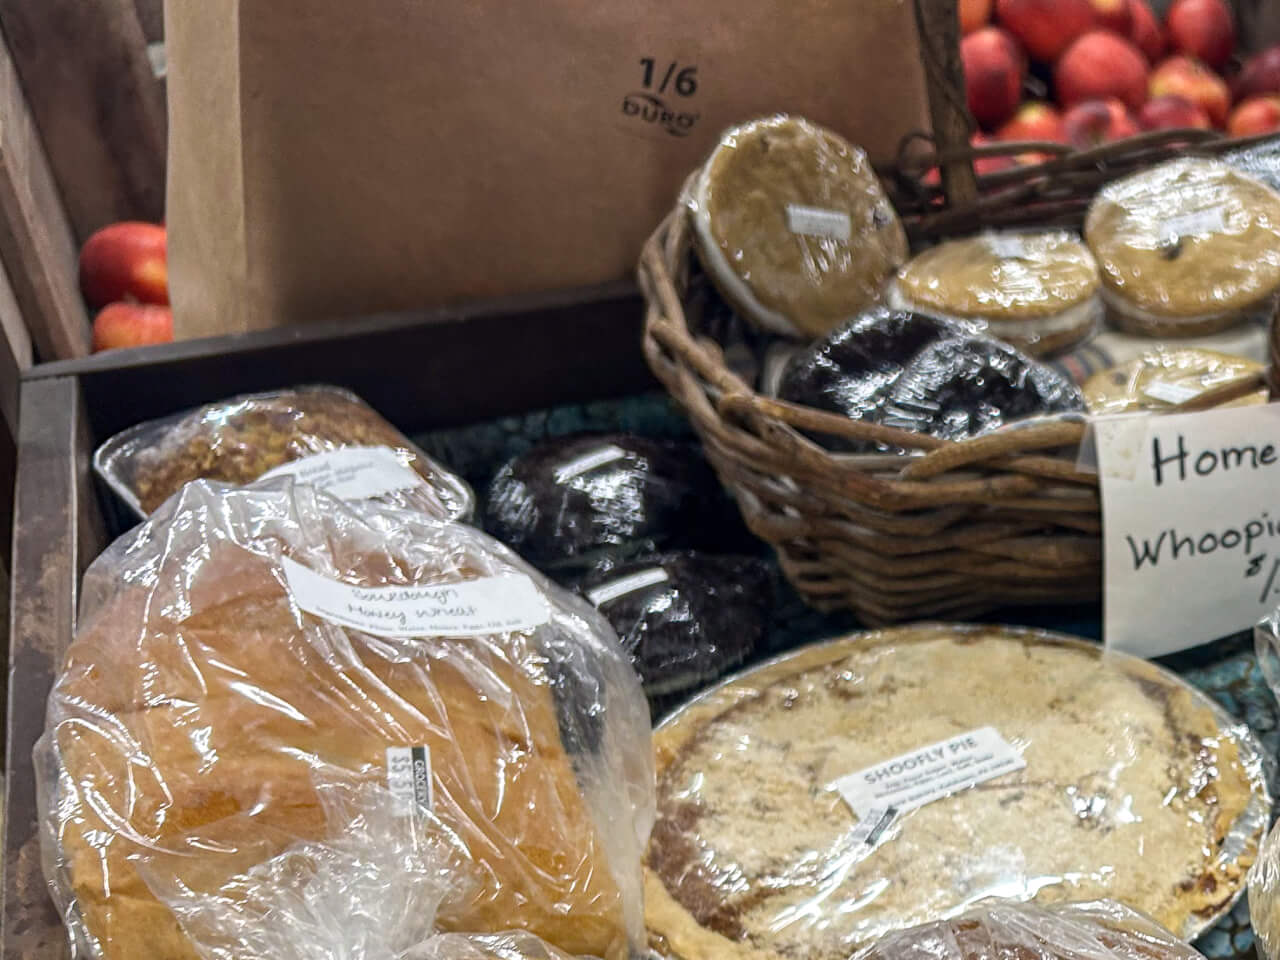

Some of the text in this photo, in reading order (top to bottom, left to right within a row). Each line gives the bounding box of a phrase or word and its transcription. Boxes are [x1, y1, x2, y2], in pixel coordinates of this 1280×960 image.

[640, 58, 698, 97] 1/6
[1152, 434, 1279, 487] Home
[863, 748, 945, 785] SHOOFLY
[947, 736, 979, 755] PIE
